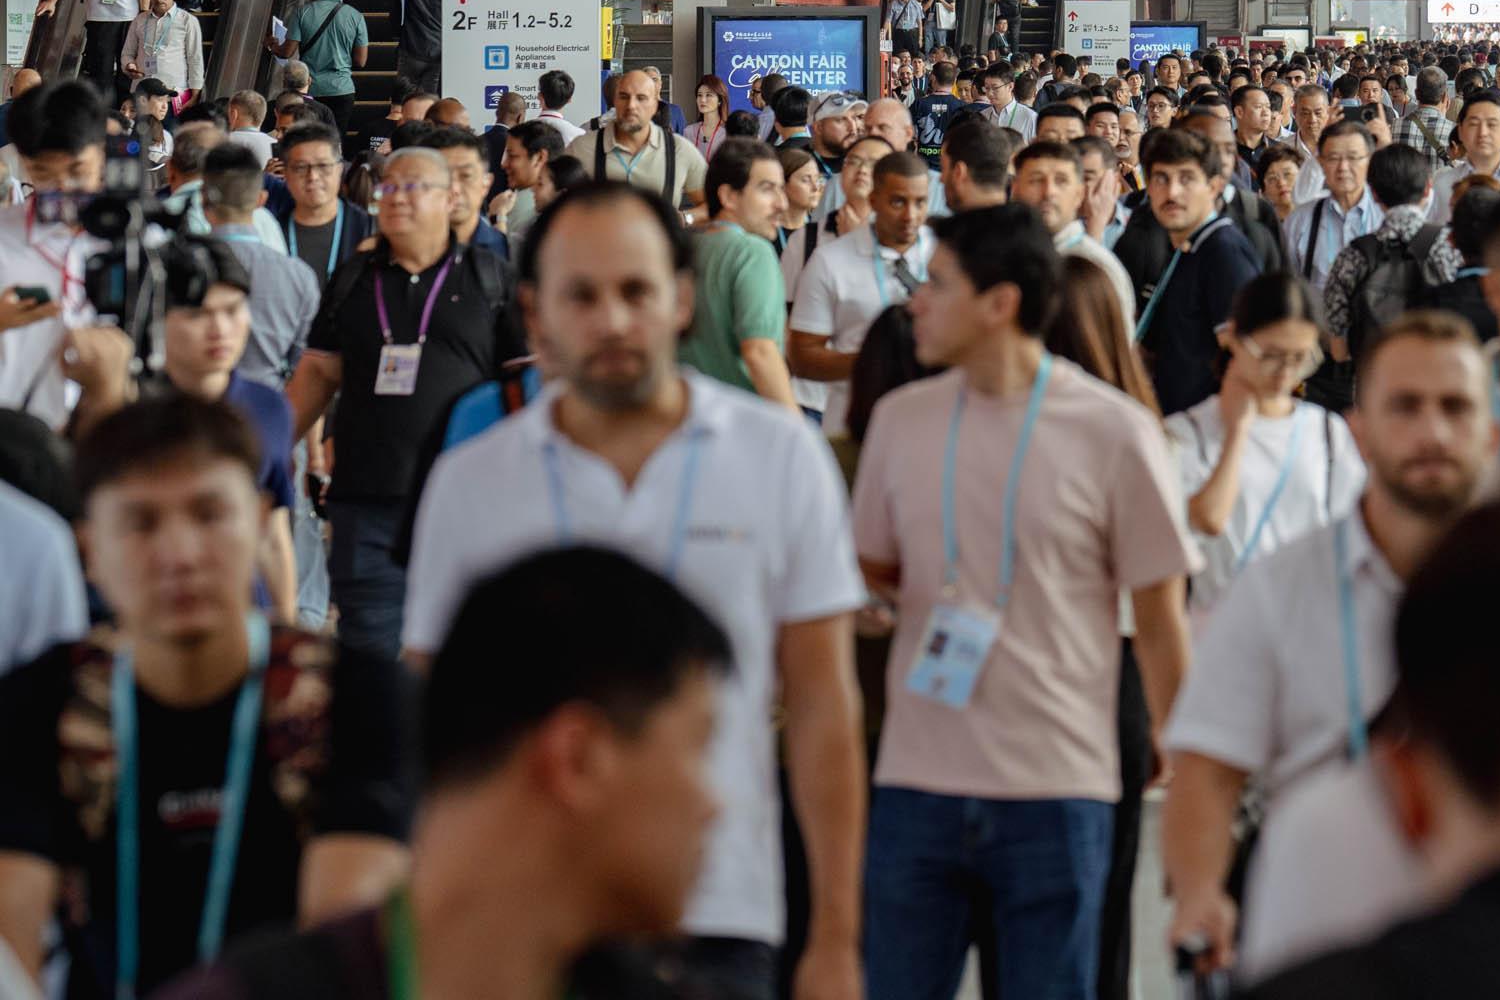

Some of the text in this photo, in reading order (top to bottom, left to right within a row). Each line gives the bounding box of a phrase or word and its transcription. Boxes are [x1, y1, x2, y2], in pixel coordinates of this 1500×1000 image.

[1469, 3, 1479, 14] D
[487, 10, 509, 19] Hall
[452, 10, 573, 30] 2F 1.2-5.2
[487, 20, 509, 30] 展厅
[1068, 24, 1119, 32] 2F 1.2-5.2
[1134, 44, 1171, 52] CANTON
[515, 62, 546, 70] 家用电器
[731, 54, 847, 69] CANTON FAIR
[781, 71, 847, 85] CENTER
